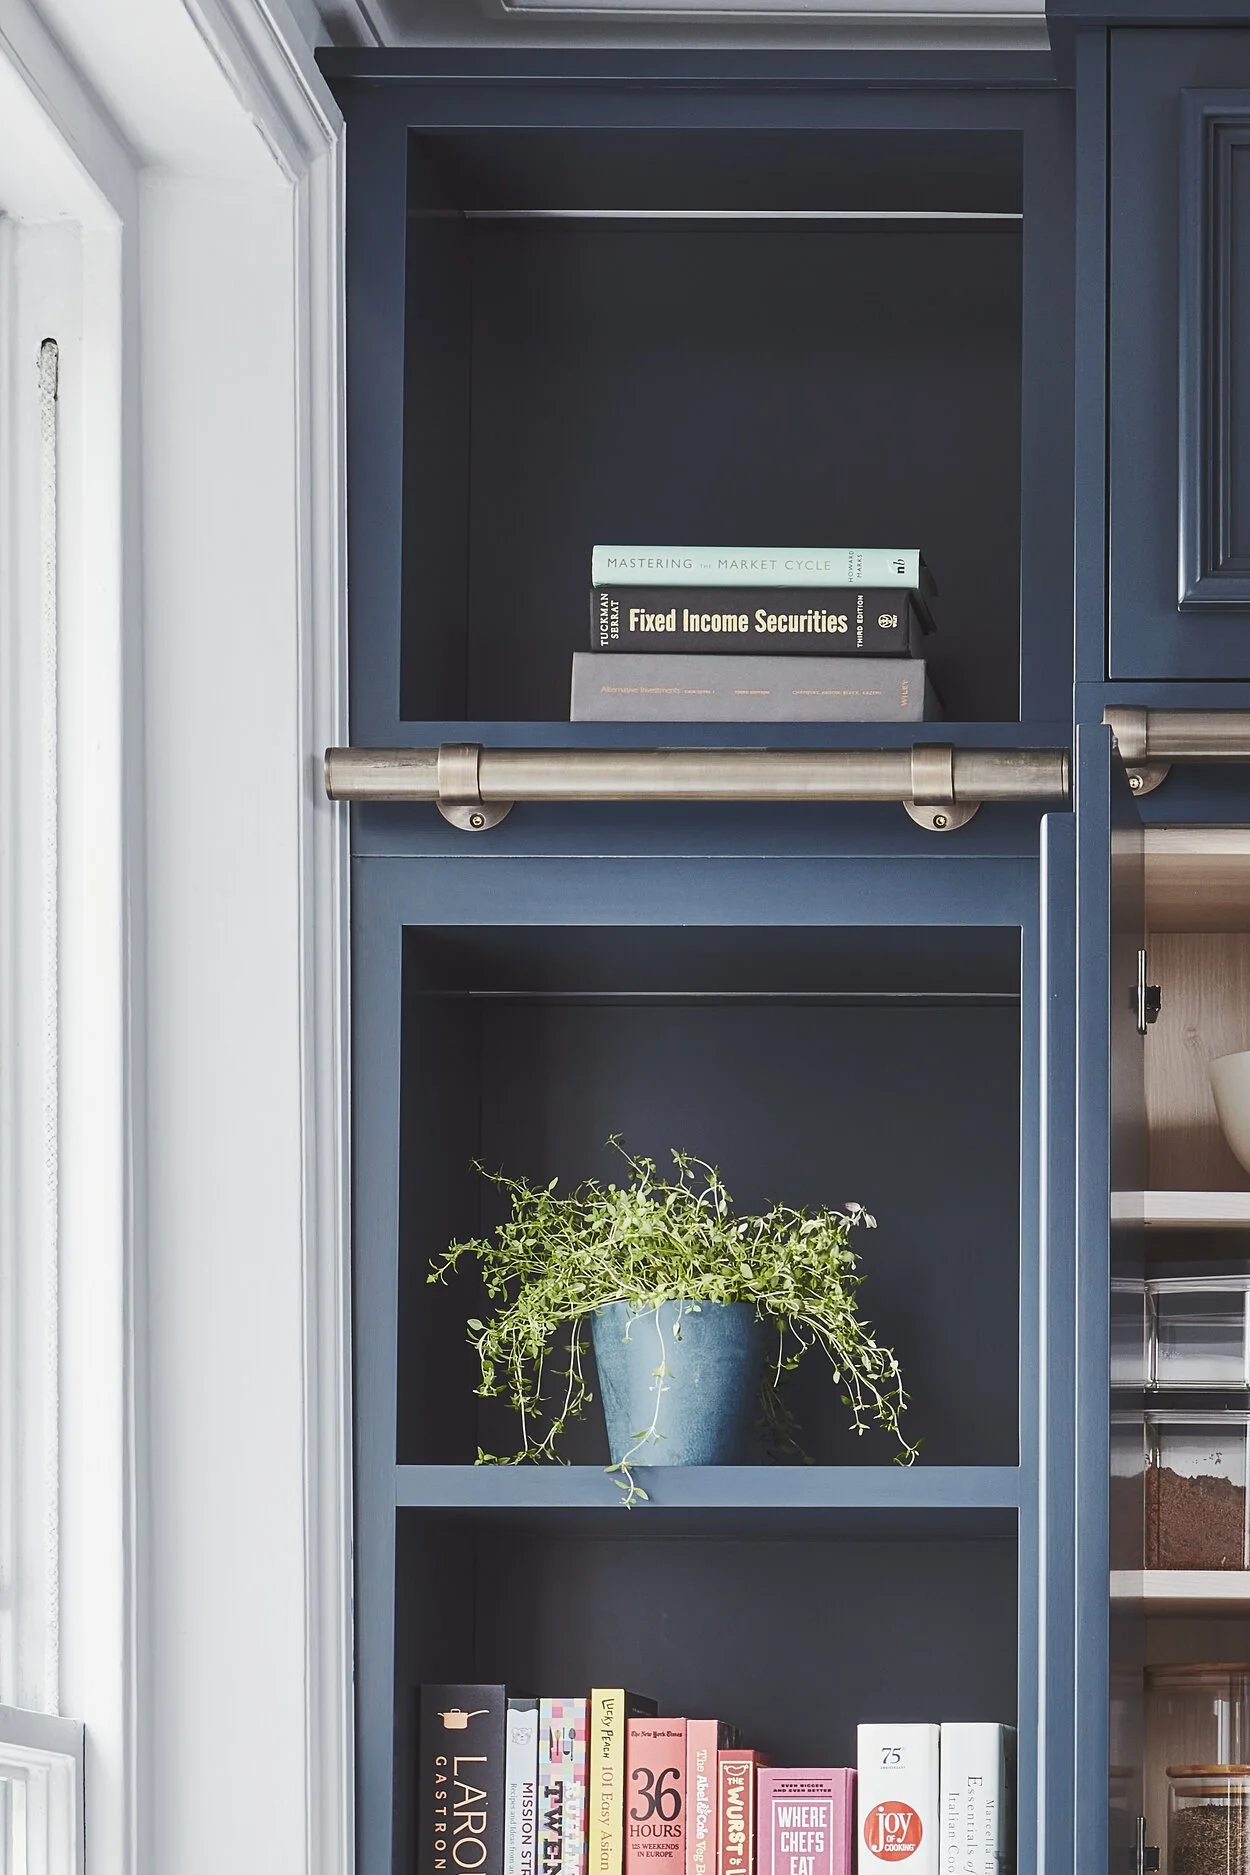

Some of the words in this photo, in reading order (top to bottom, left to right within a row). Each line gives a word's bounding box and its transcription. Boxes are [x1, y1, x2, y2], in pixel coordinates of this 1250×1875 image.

[607, 558, 693, 569] MASTERING
[718, 559, 778, 570] MARKET
[784, 560, 831, 571] CYCLE
[600, 593, 609, 647] TUCKMAN
[610, 600, 620, 640] SERRAT
[629, 608, 676, 632] Fixed
[683, 608, 749, 632] Income
[754, 608, 849, 633] Securities
[856, 594, 864, 624] EDITION
[856, 625, 864, 648] THIRD
[900, 679, 910, 708] WILEY
[696, 1750, 707, 1772] The
[602, 1766, 614, 1787] 101
[726, 1777, 745, 1785] THE
[508, 1783, 517, 1810] Recipes
[630, 1767, 682, 1821] 36
[509, 1811, 517, 1825] and
[521, 1782, 534, 1845] MISSION
[599, 1792, 614, 1826] Easy
[725, 1785, 746, 1856] WURST
[777, 1806, 828, 1828] WHERE
[947, 1791, 960, 1839] Italian
[966, 1775, 983, 1856] Essentials
[509, 1826, 517, 1845] Ideas
[629, 1824, 682, 1837] HOURS
[871, 1805, 914, 1853] joy
[886, 1834, 897, 1843] OF
[984, 1799, 995, 1855] Marcella
[600, 1830, 613, 1871] Asian
[694, 1840, 707, 1863] Veg
[780, 1831, 825, 1853] CHEFS
[508, 1846, 516, 1864] from
[729, 1857, 743, 1865] OF
[508, 1865, 514, 1875] an
